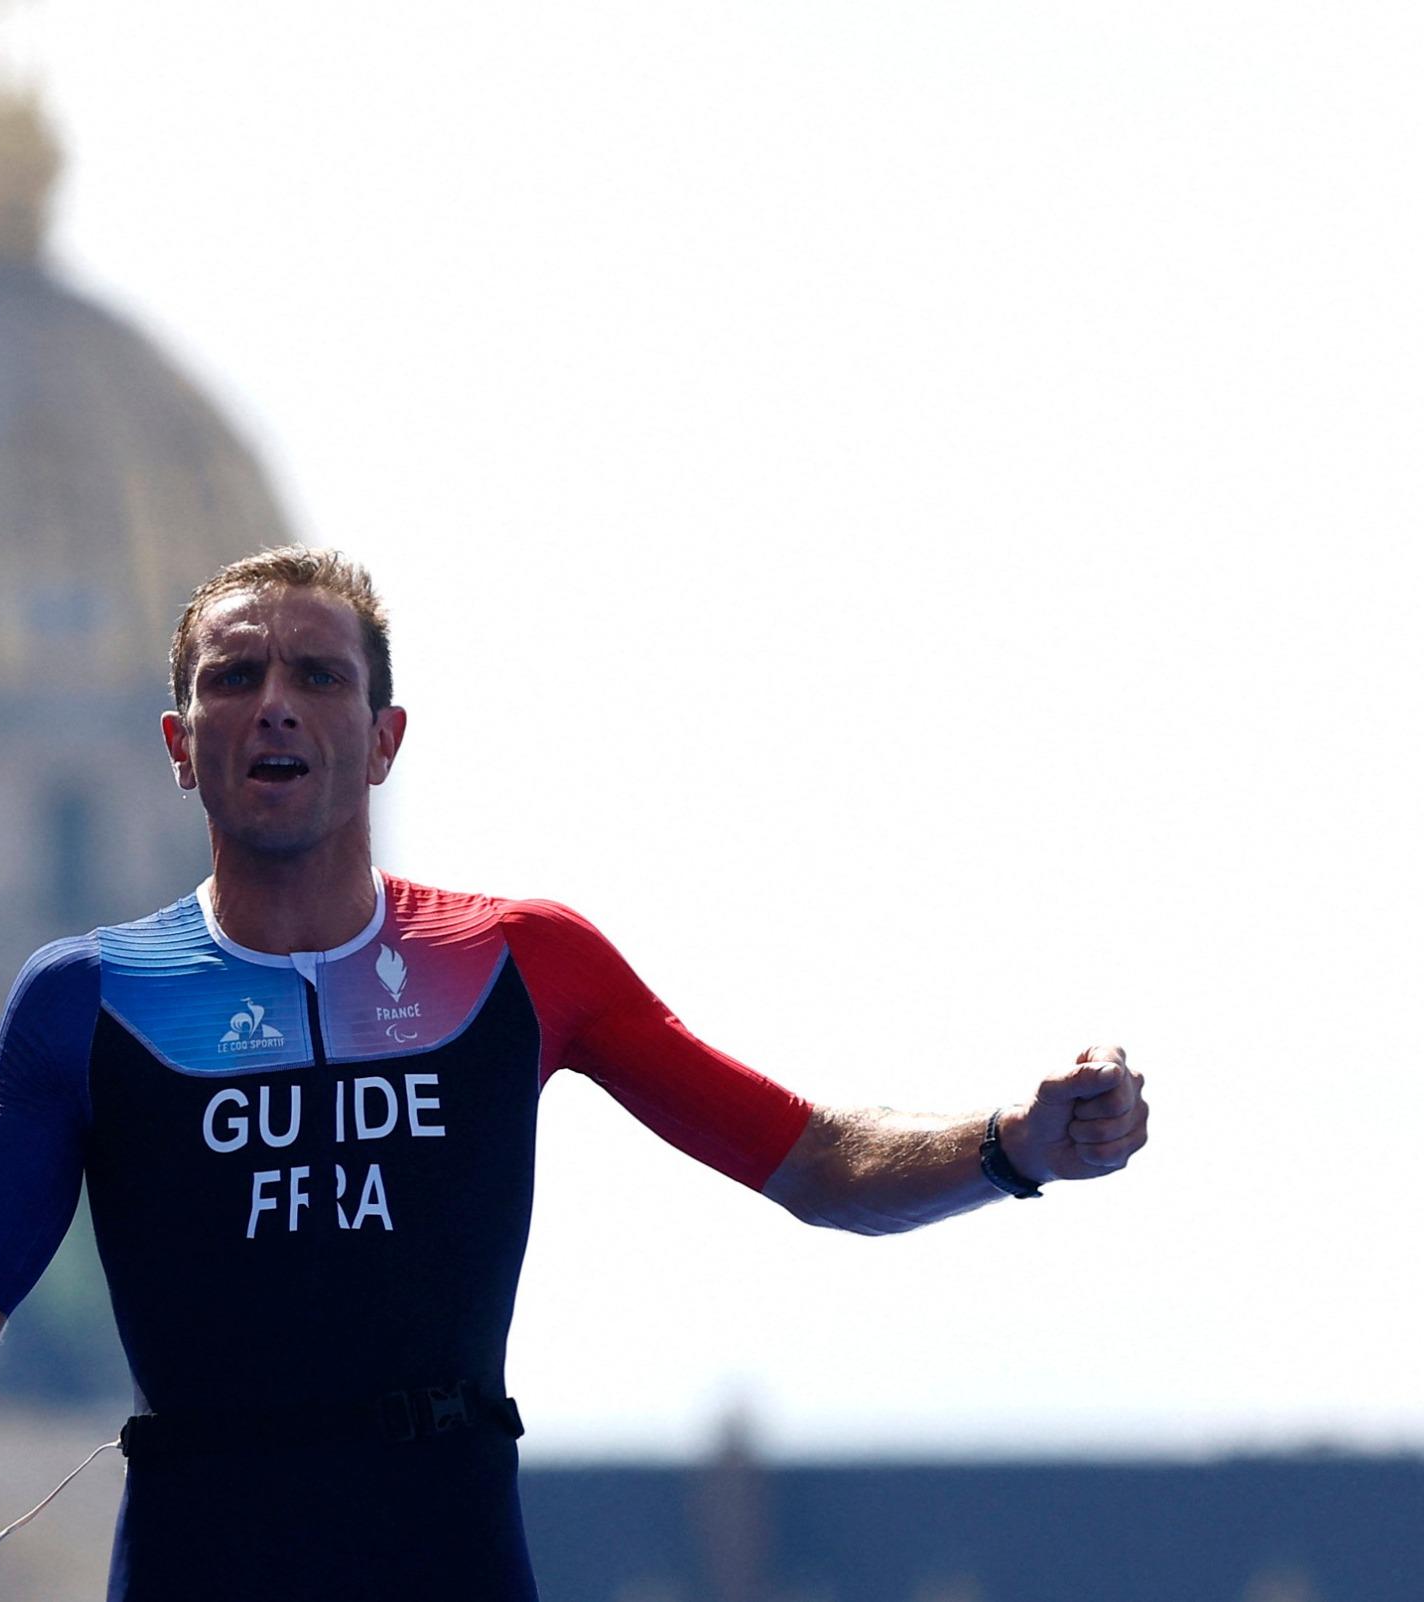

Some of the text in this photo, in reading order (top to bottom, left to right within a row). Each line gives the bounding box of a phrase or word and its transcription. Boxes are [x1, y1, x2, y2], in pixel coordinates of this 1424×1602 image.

[376, 1003, 421, 1021] FRANCE
[218, 1038, 284, 1053] LE COQ SPORTIF
[202, 1073, 446, 1153] GUIDE
